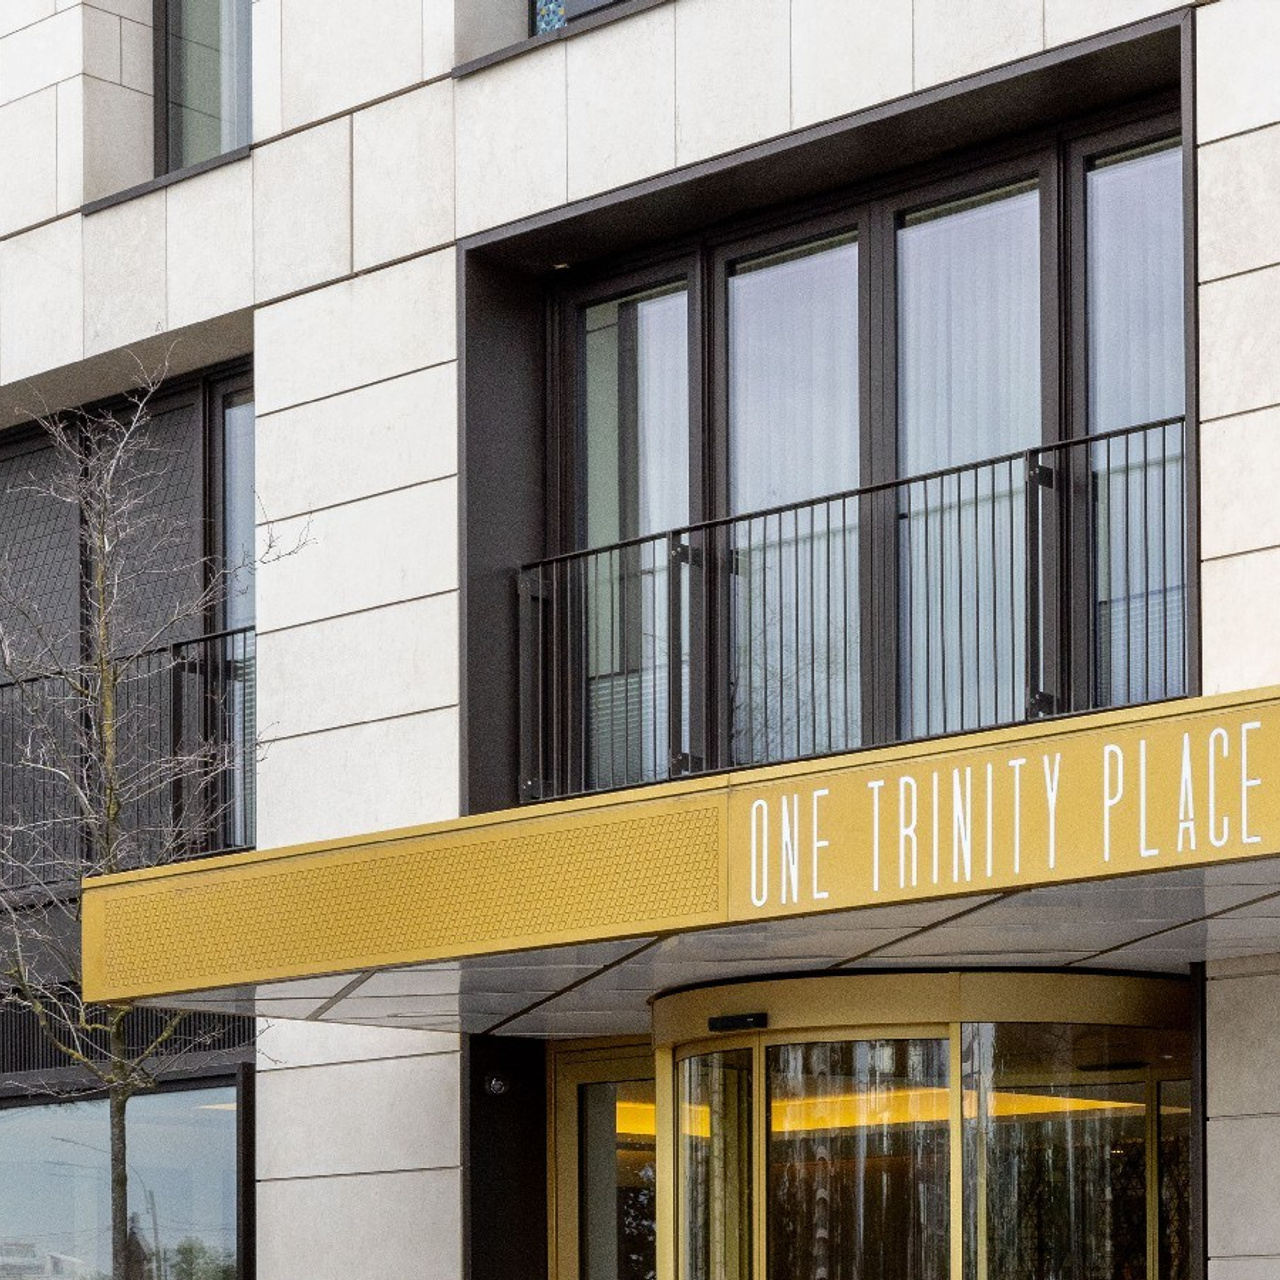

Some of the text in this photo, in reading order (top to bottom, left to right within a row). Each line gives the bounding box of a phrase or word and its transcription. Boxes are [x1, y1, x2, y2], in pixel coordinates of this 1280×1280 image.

[750, 720, 1263, 908] ONE TRINITY PLACE
